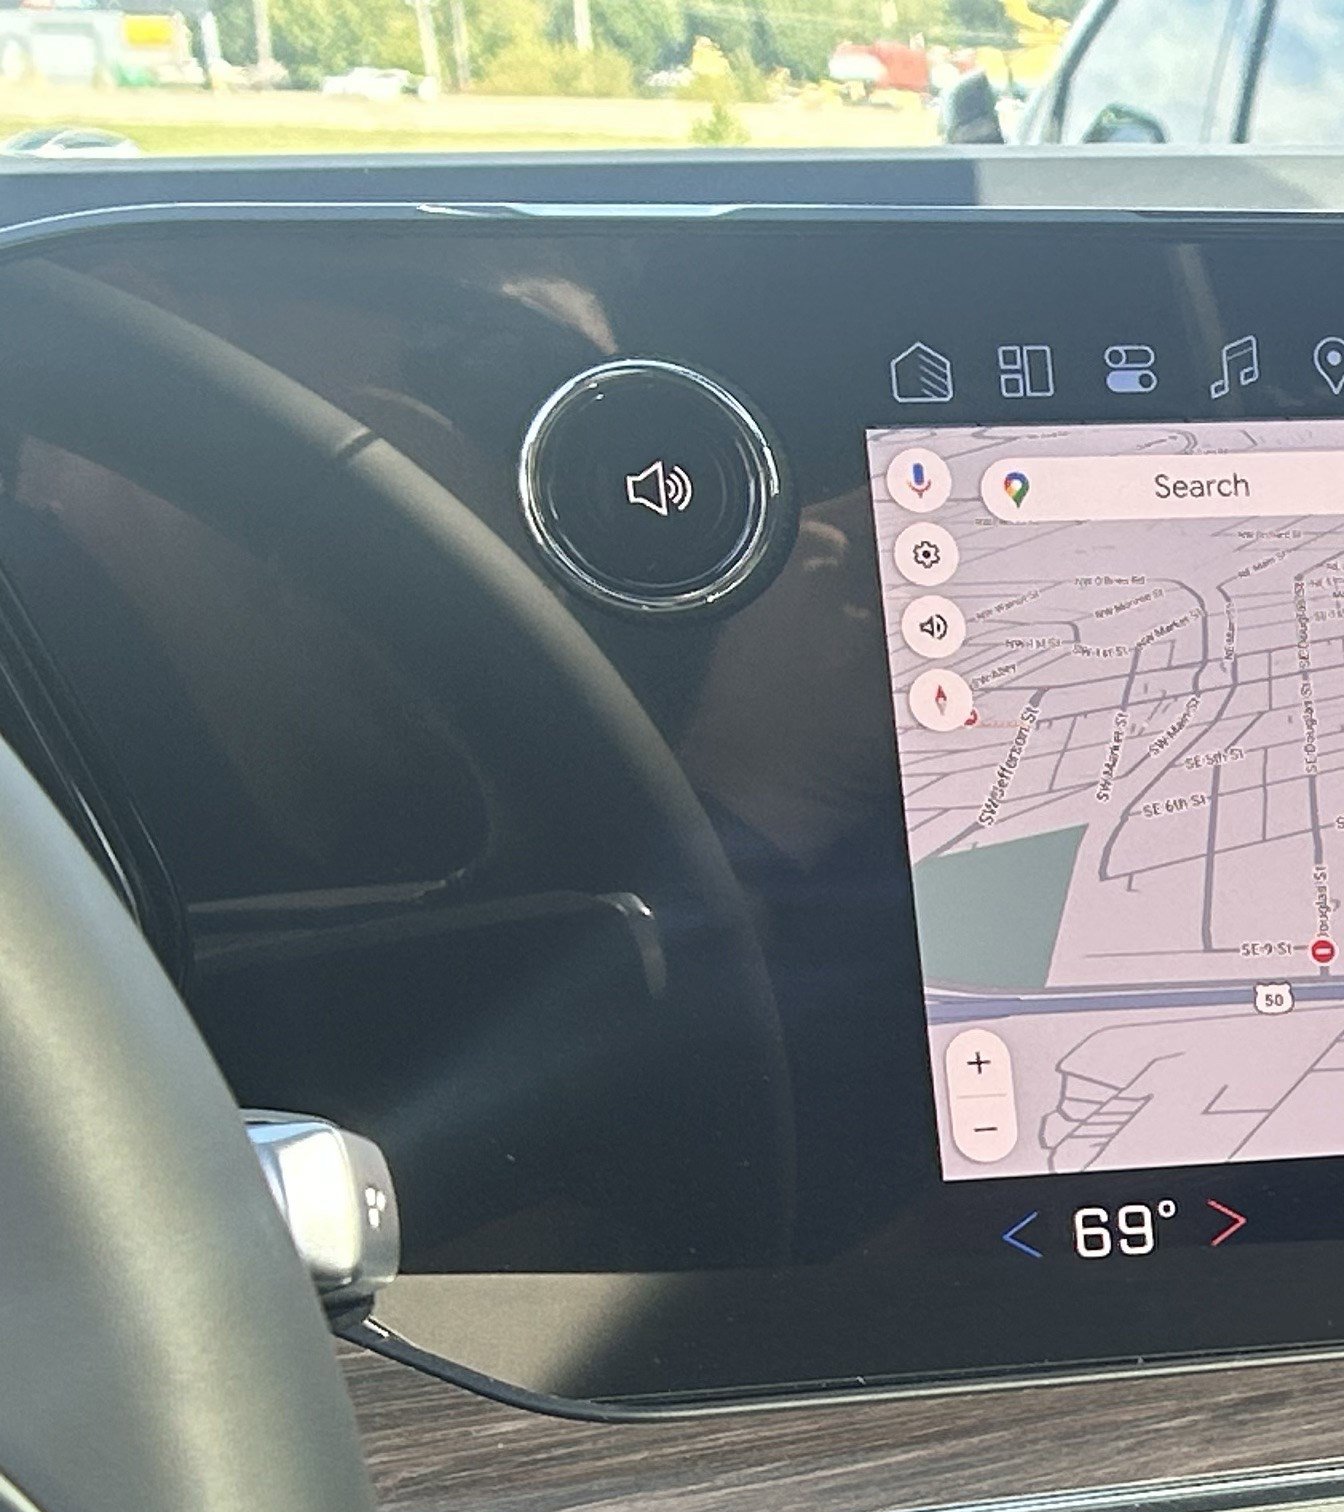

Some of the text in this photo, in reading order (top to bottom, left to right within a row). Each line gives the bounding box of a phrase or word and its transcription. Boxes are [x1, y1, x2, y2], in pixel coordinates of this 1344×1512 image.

[1154, 472, 1250, 498] Search
[1166, 712, 1190, 738] Main
[991, 726, 1029, 799] Jefferson
[1022, 706, 1040, 724] St
[1102, 731, 1125, 780] Market
[1185, 748, 1244, 769] SE 5th St
[1143, 794, 1206, 816] SE 6th St
[1313, 866, 1326, 880] St
[1241, 944, 1261, 955] SE
[1277, 943, 1292, 954] St
[1266, 995, 1283, 1007] 50
[1073, 1201, 1177, 1258] 69°
